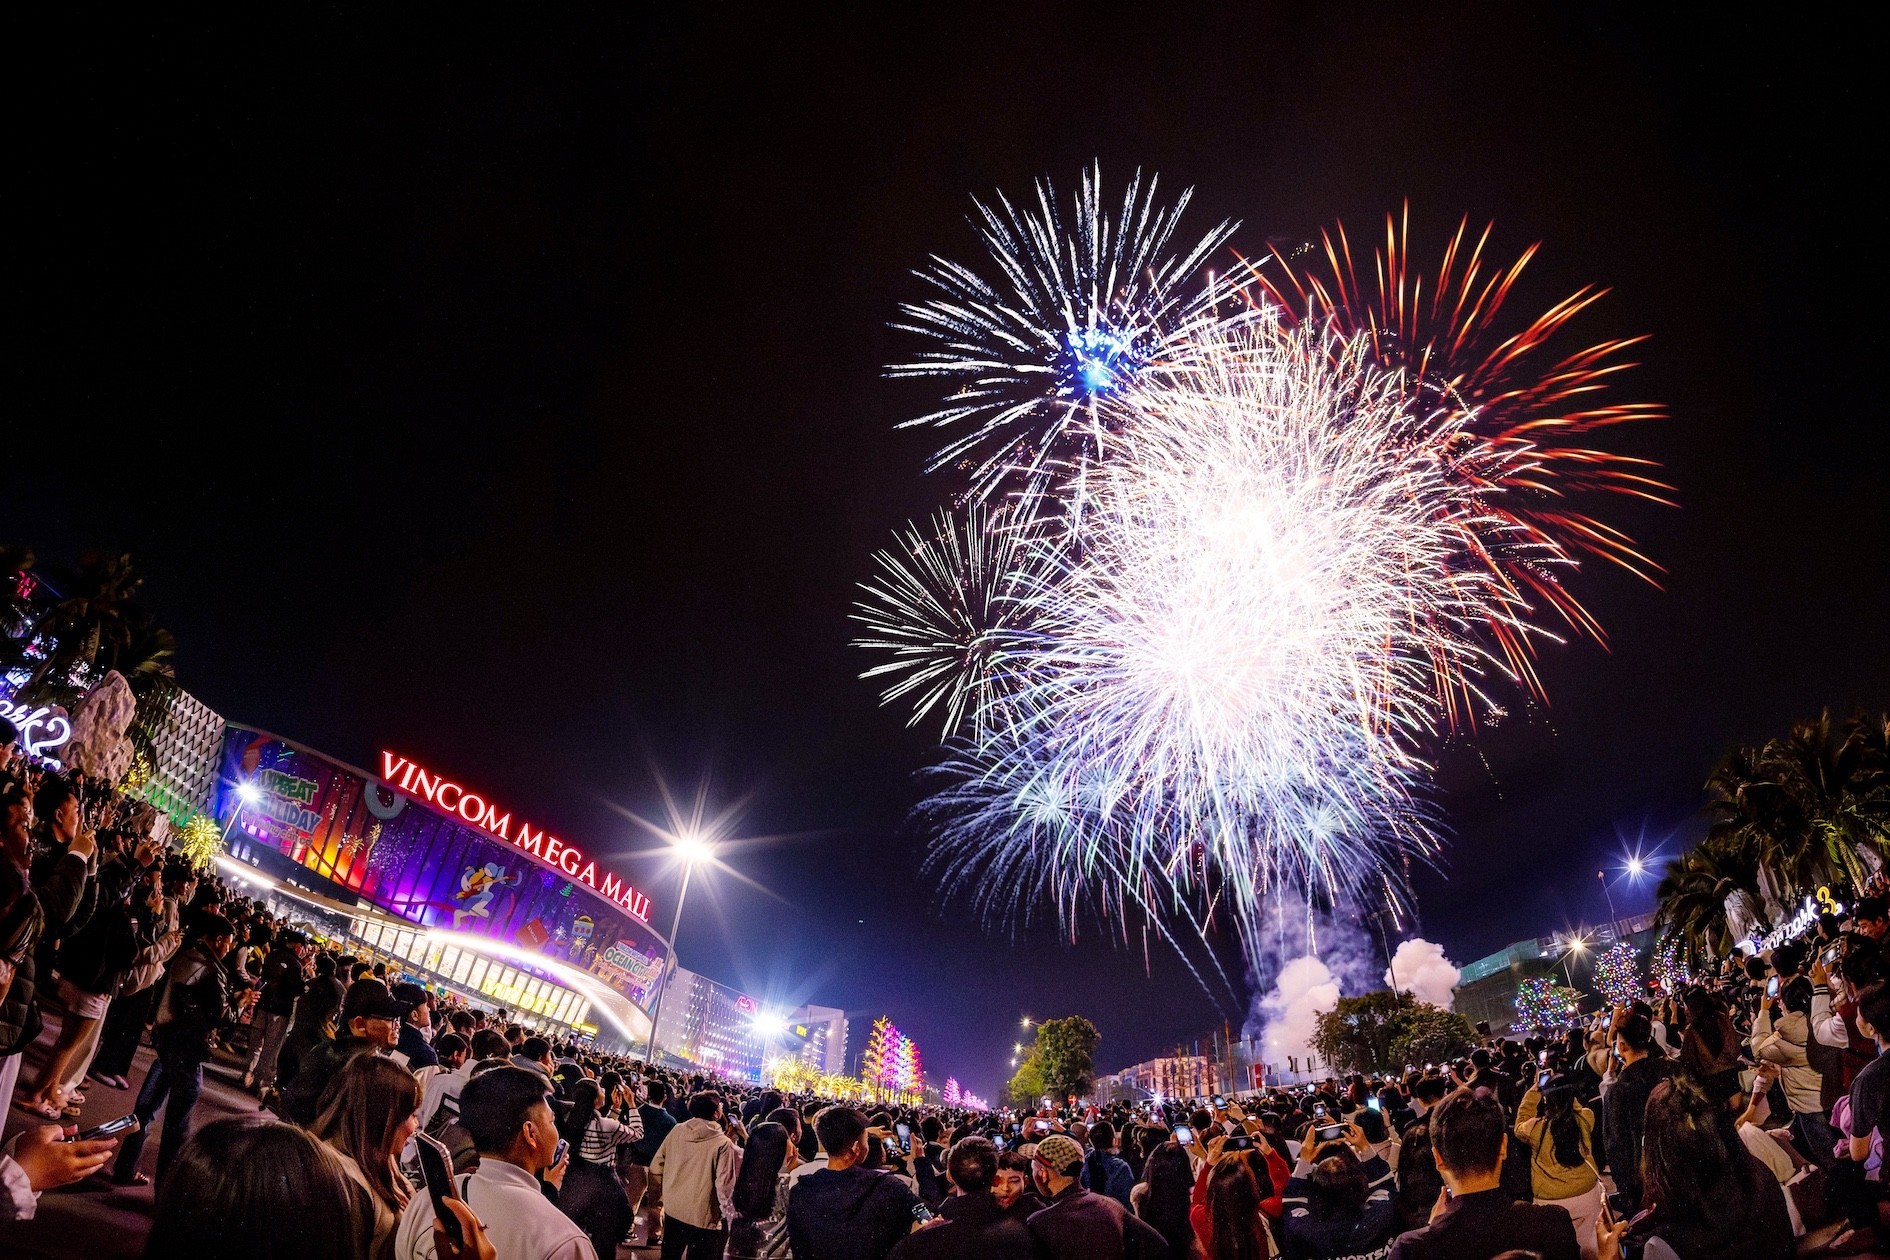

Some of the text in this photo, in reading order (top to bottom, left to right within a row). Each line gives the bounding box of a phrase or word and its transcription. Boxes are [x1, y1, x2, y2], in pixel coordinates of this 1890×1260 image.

[261, 769, 319, 805] UPBEAT
[382, 750, 652, 923] VINCOM MEGA MALL
[604, 947, 633, 972] OCEAN
